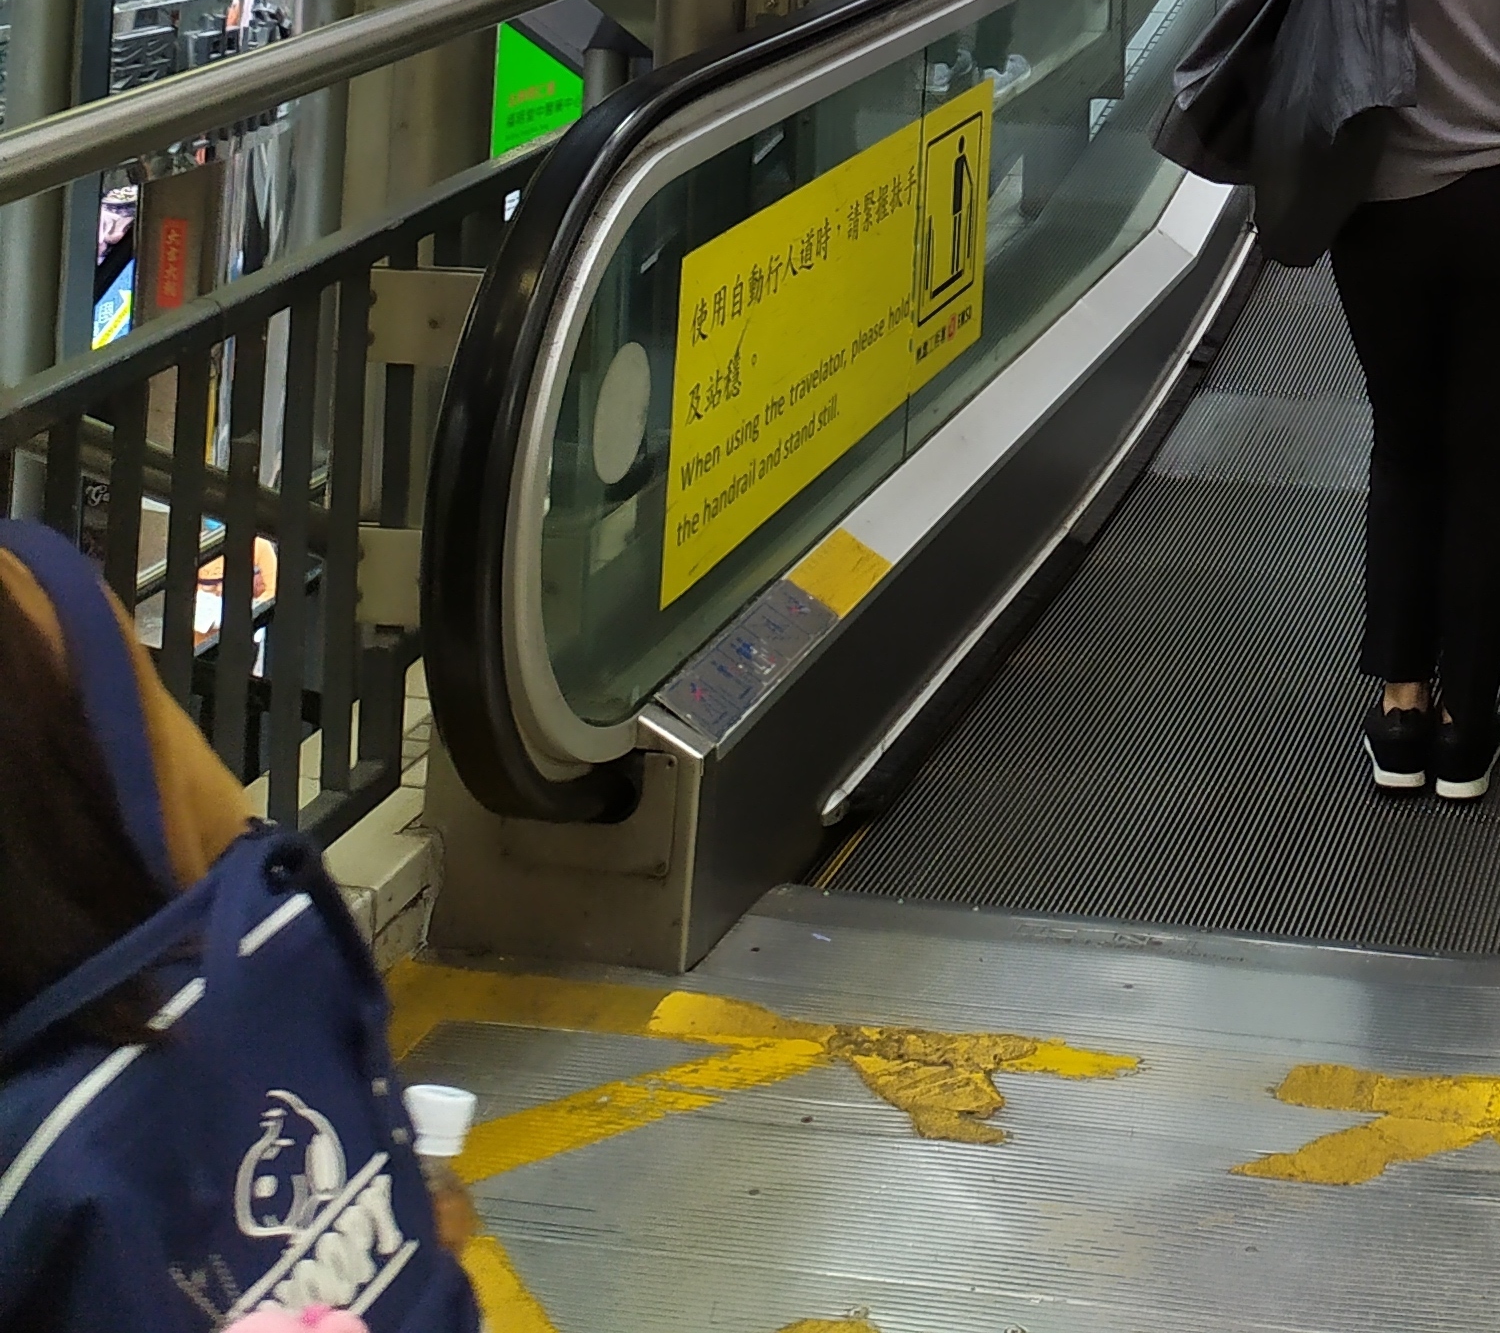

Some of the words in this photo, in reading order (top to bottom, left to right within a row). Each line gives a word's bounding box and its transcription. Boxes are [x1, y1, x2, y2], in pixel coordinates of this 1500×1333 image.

[676, 512, 700, 548] the
[702, 458, 757, 527] handrail
[757, 438, 782, 481] and
[783, 409, 816, 460] stand
[816, 393, 840, 433] still.
[680, 443, 720, 491] When
[726, 412, 760, 457] using
[764, 393, 786, 426] the
[789, 347, 847, 407] travelator,
[850, 318, 886, 365] please
[888, 292, 911, 327] hold
